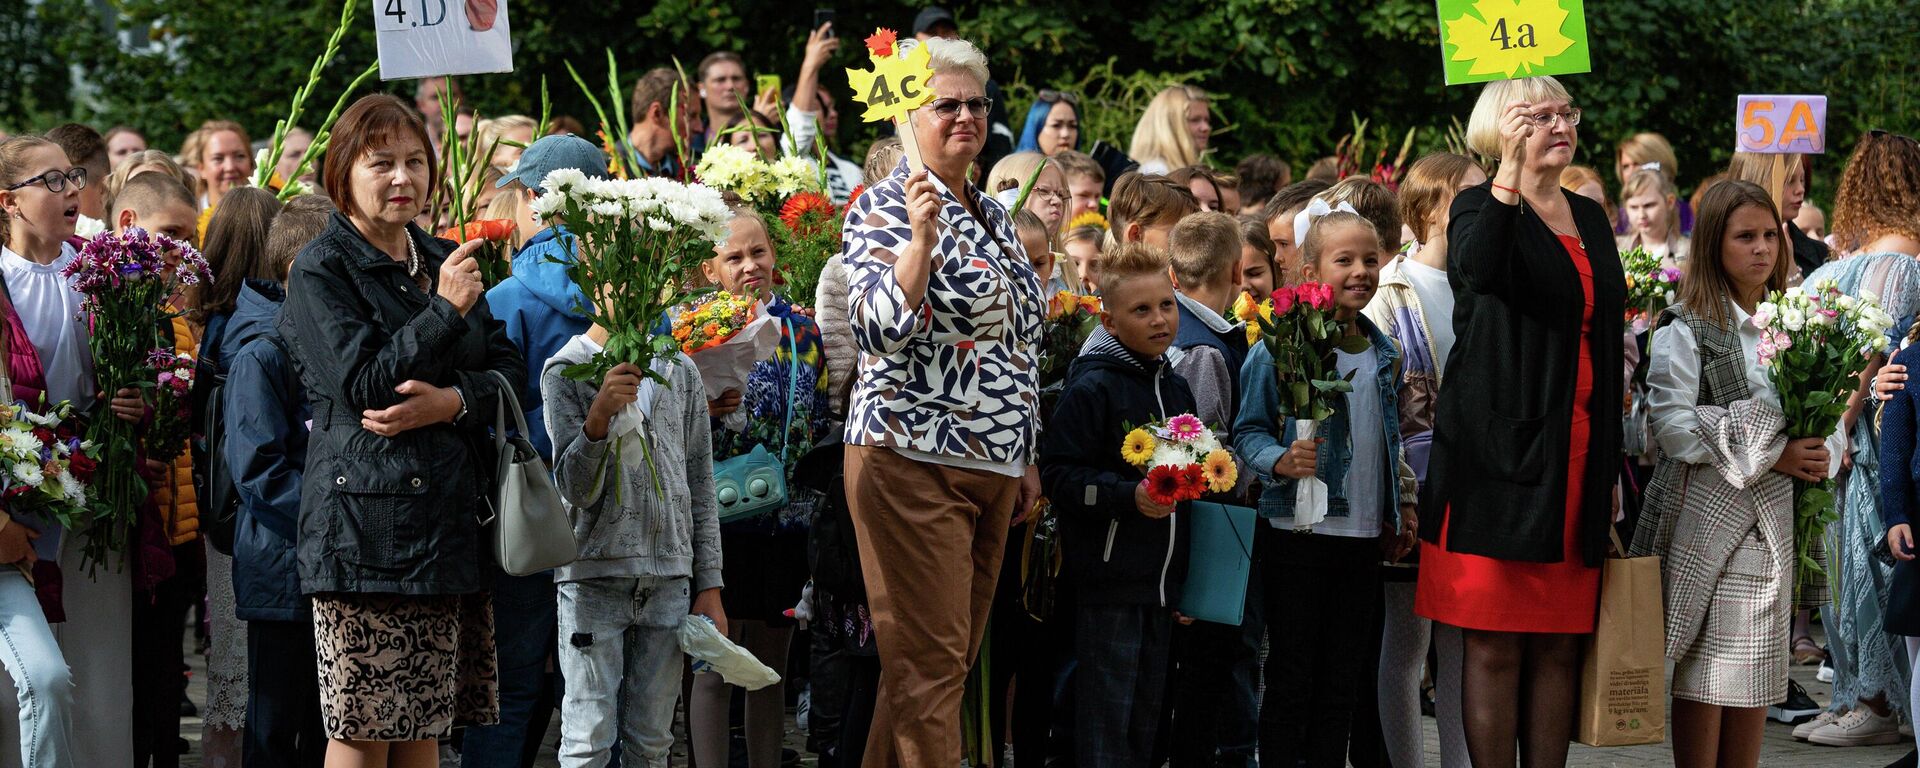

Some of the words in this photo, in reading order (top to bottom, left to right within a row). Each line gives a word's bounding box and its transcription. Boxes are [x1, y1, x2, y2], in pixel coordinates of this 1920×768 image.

[385, 0, 446, 27] 4.D
[1490, 17, 1538, 50] 4.a
[867, 74, 921, 107] 4.c
[1740, 100, 1823, 152] 5A
